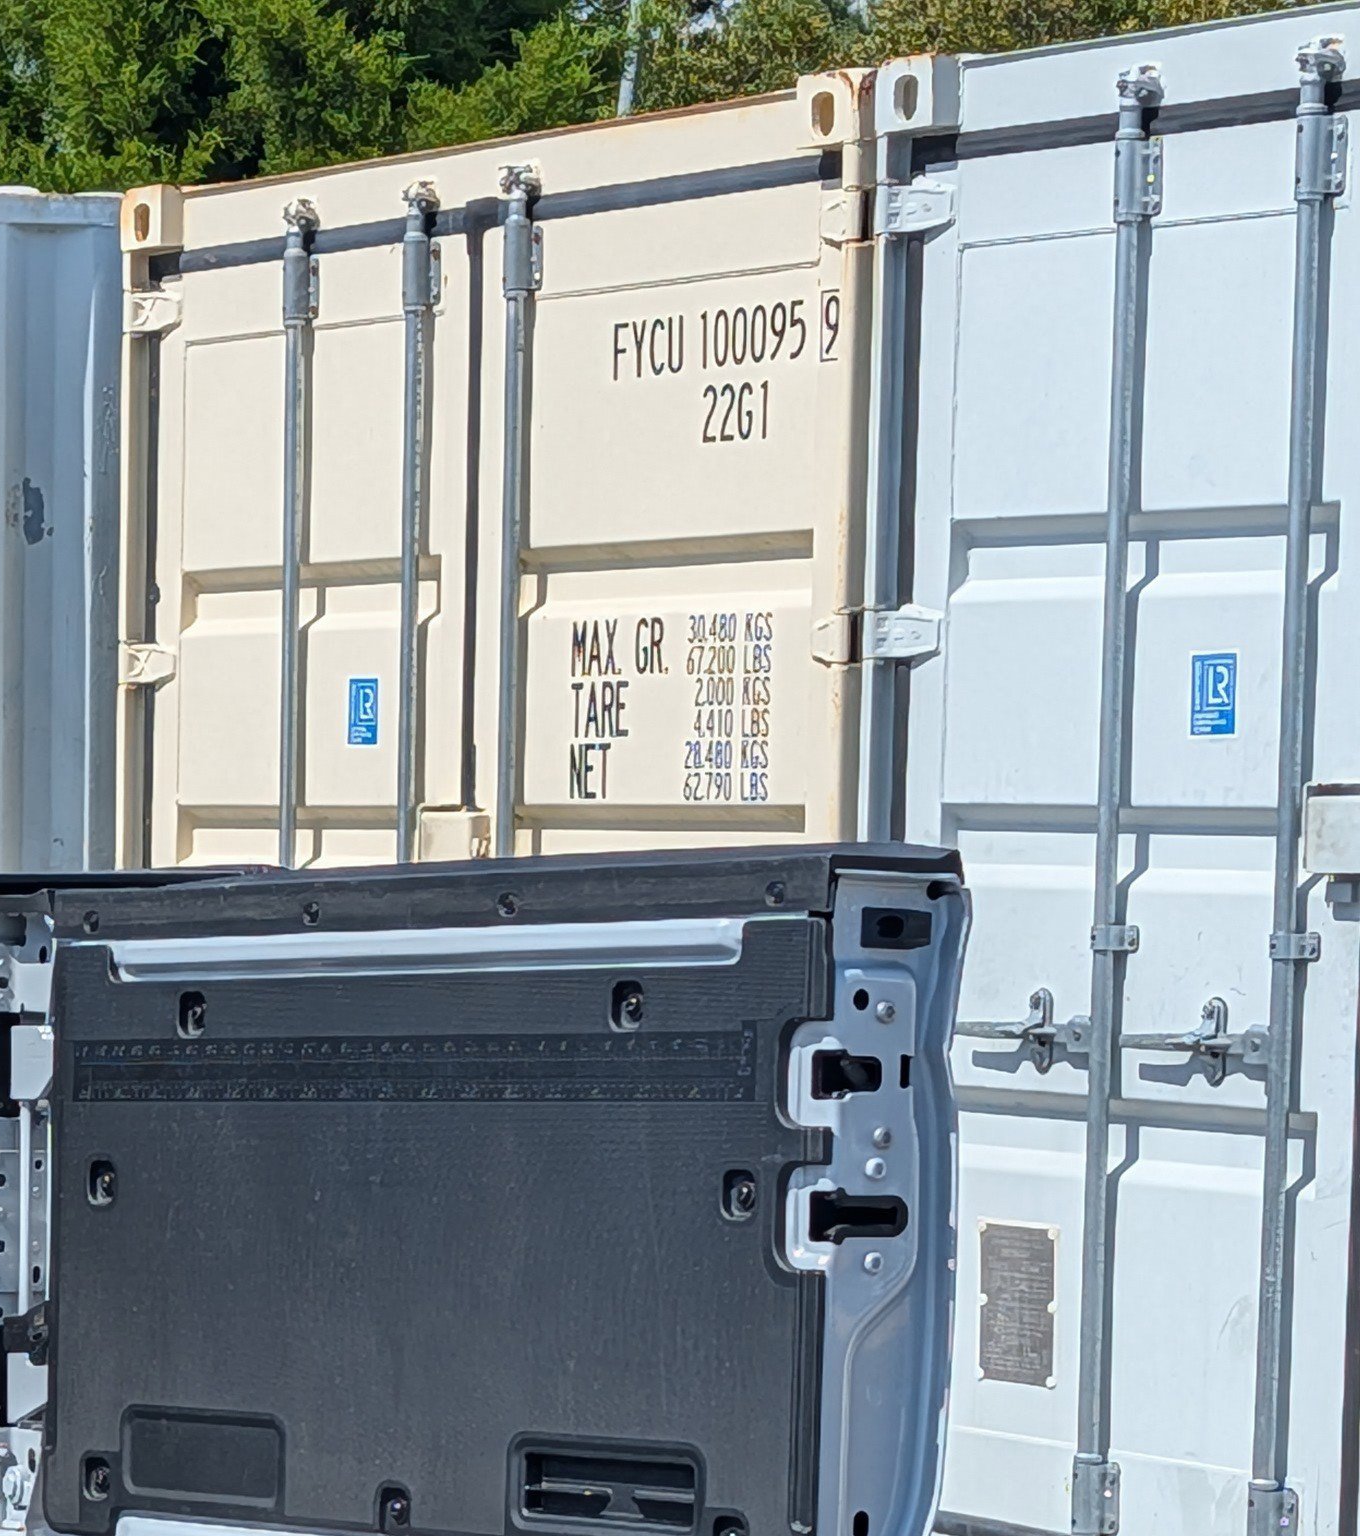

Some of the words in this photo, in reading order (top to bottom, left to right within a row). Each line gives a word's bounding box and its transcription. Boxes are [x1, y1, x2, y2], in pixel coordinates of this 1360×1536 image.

[613, 315, 684, 381] FYCU
[700, 299, 807, 369] 100095
[825, 295, 840, 355] 9
[702, 380, 769, 443] 22G1
[571, 618, 622, 677] MAX.
[635, 617, 669, 675] GR.
[745, 612, 773, 641] KGS
[744, 644, 772, 674] LBS
[571, 680, 629, 738] TARE
[742, 676, 771, 706] KGS
[742, 708, 770, 737] LBS
[569, 743, 611, 799] NET
[741, 740, 769, 769] KGS
[740, 772, 769, 801] LBS
